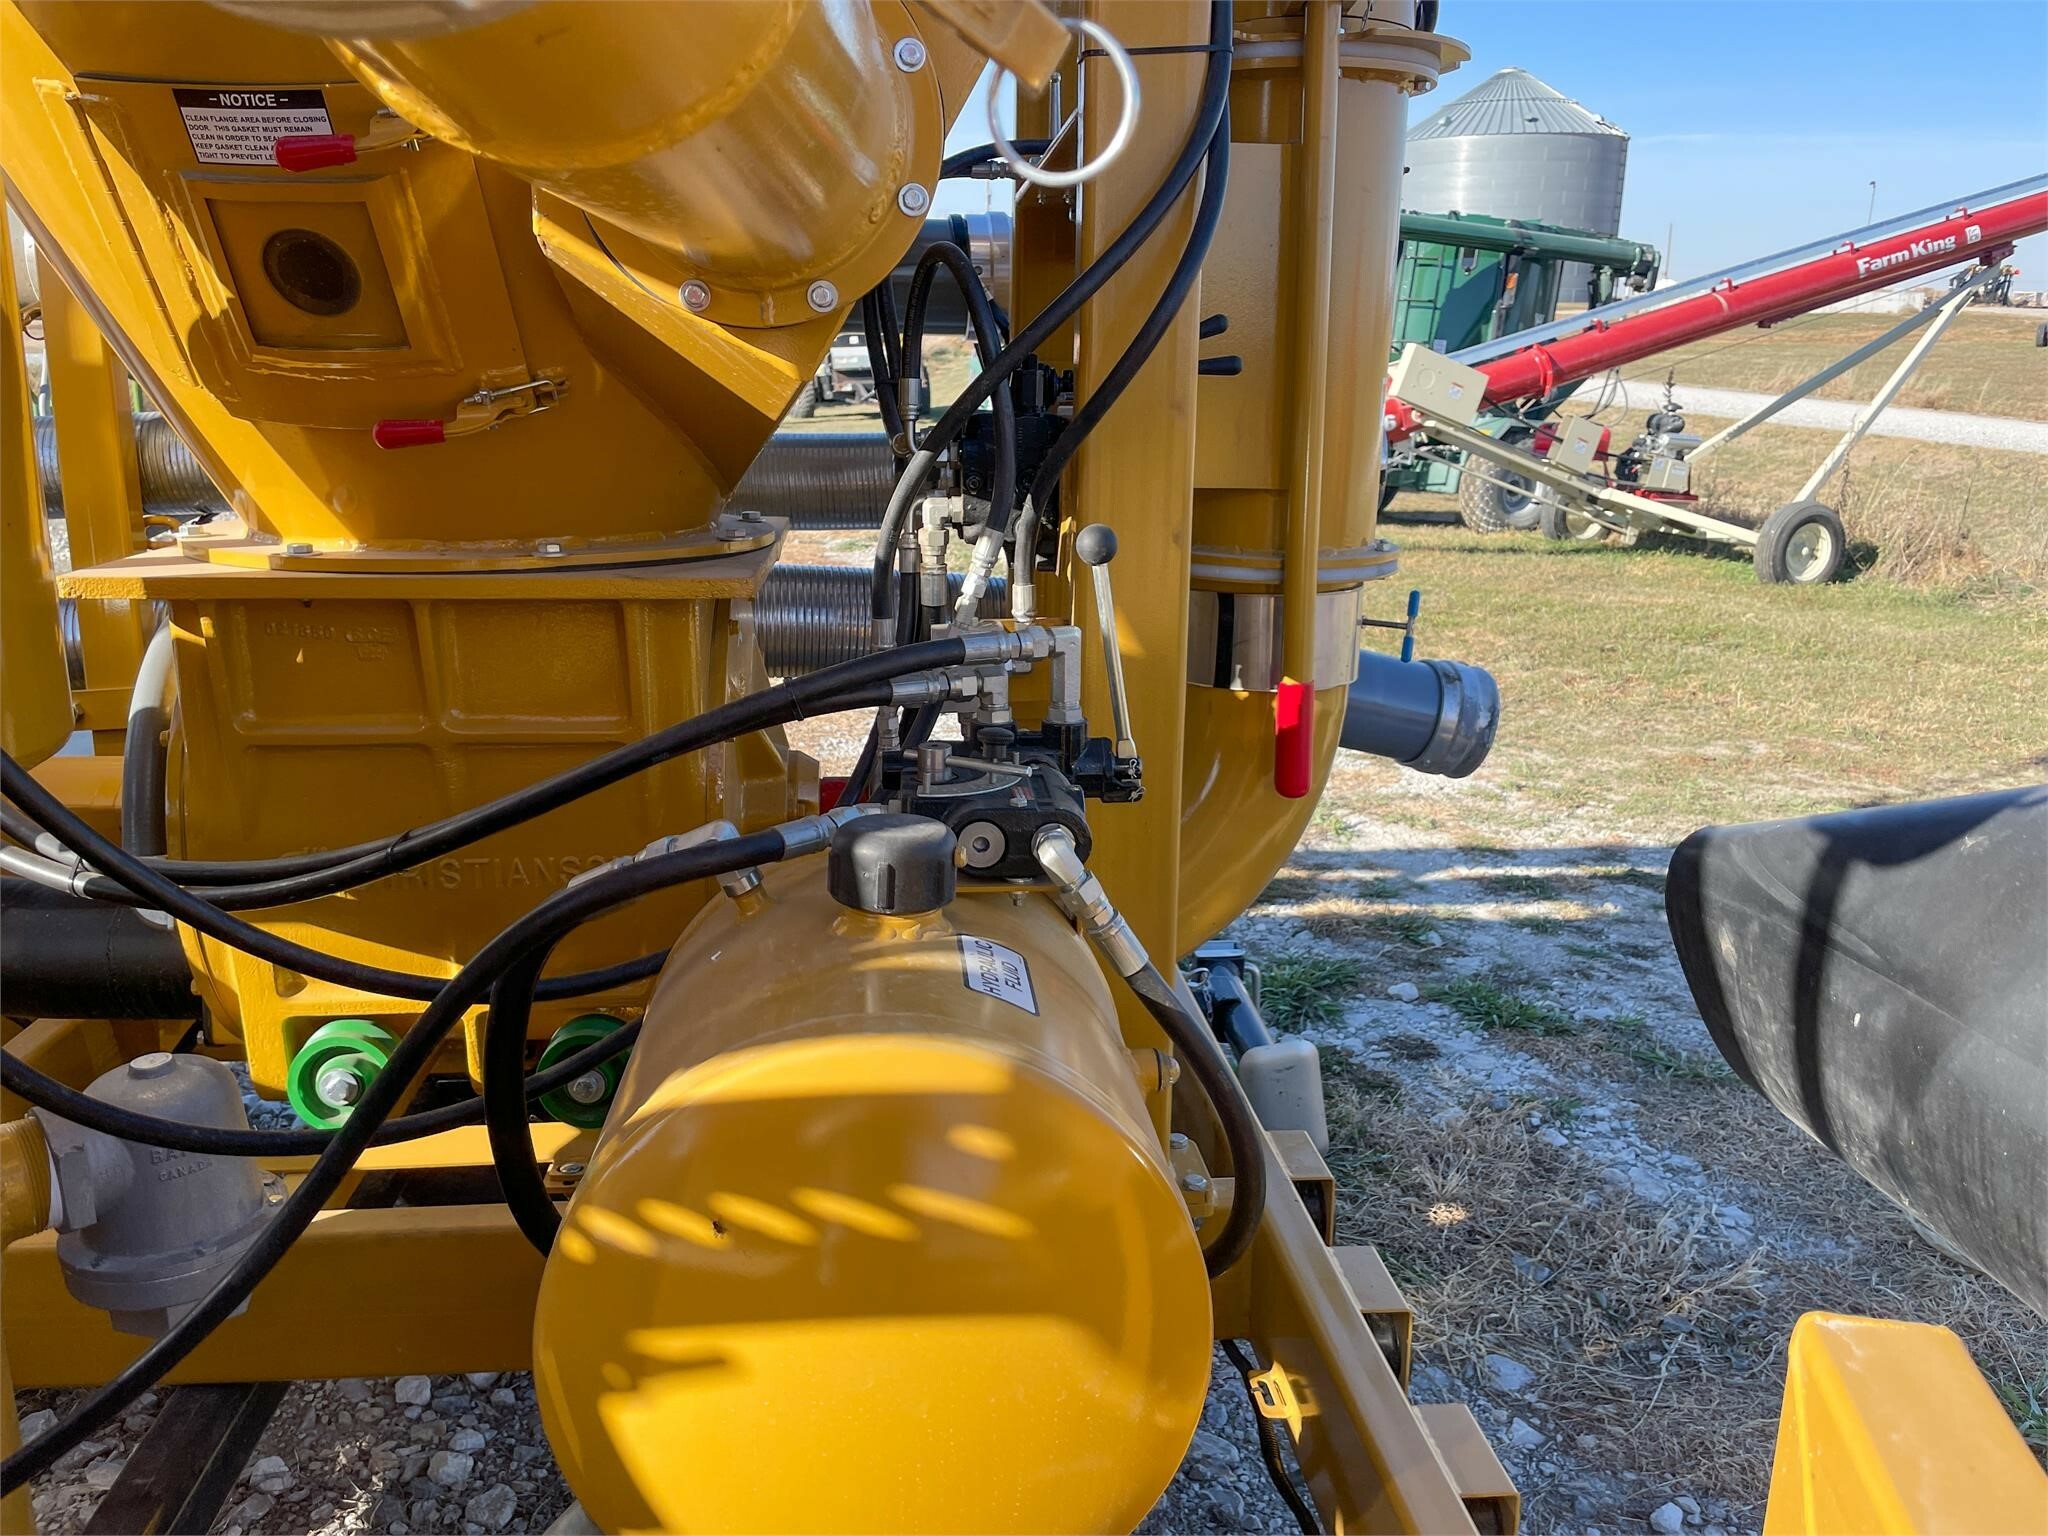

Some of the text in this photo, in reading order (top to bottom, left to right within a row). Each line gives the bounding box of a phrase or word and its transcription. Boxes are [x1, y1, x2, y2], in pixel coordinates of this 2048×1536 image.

[219, 93, 277, 107] NOTICE
[185, 114, 209, 122] CLEAN
[210, 115, 239, 123] FLANGE
[231, 125, 260, 133] GASKET
[192, 133, 216, 141] CLEAN
[194, 142, 213, 150] KEEP
[214, 143, 243, 151] GASKET
[198, 151, 218, 159] TIGHT
[230, 153, 263, 161] PREVENT
[974, 939, 1002, 997] HYDRAULIC
[1001, 960, 1023, 993] FLUID
